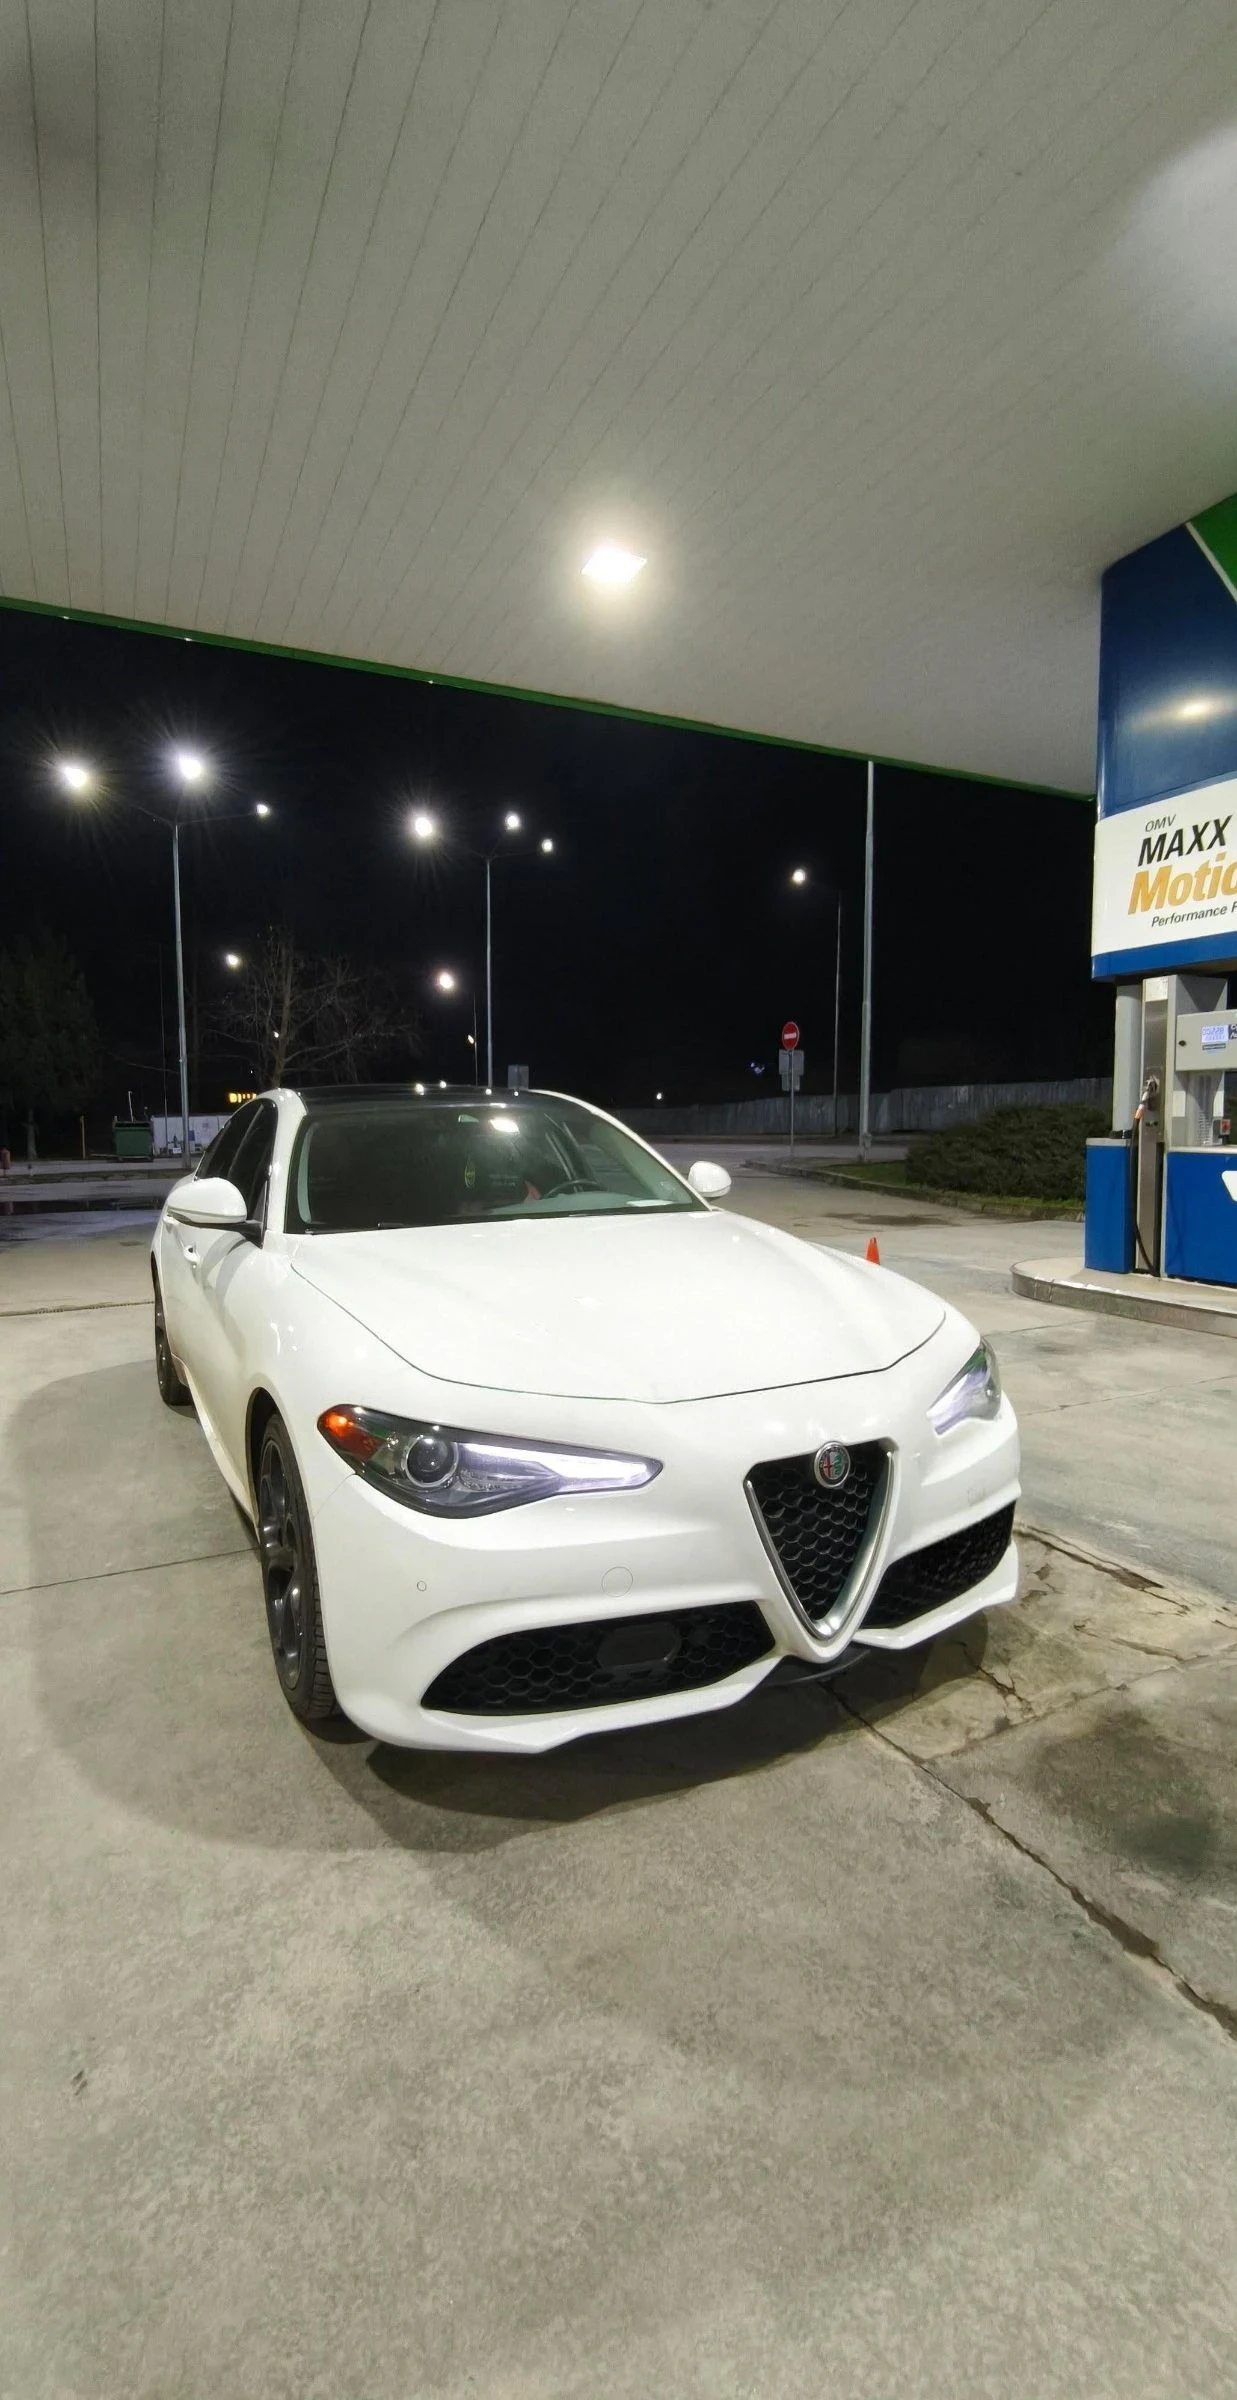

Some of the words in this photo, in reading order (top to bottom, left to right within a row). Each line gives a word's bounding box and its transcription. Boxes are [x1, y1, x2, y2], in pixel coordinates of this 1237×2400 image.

[1145, 814, 1177, 833] OMV
[1137, 814, 1233, 867] MAXX
[1151, 905, 1228, 928] Performance
